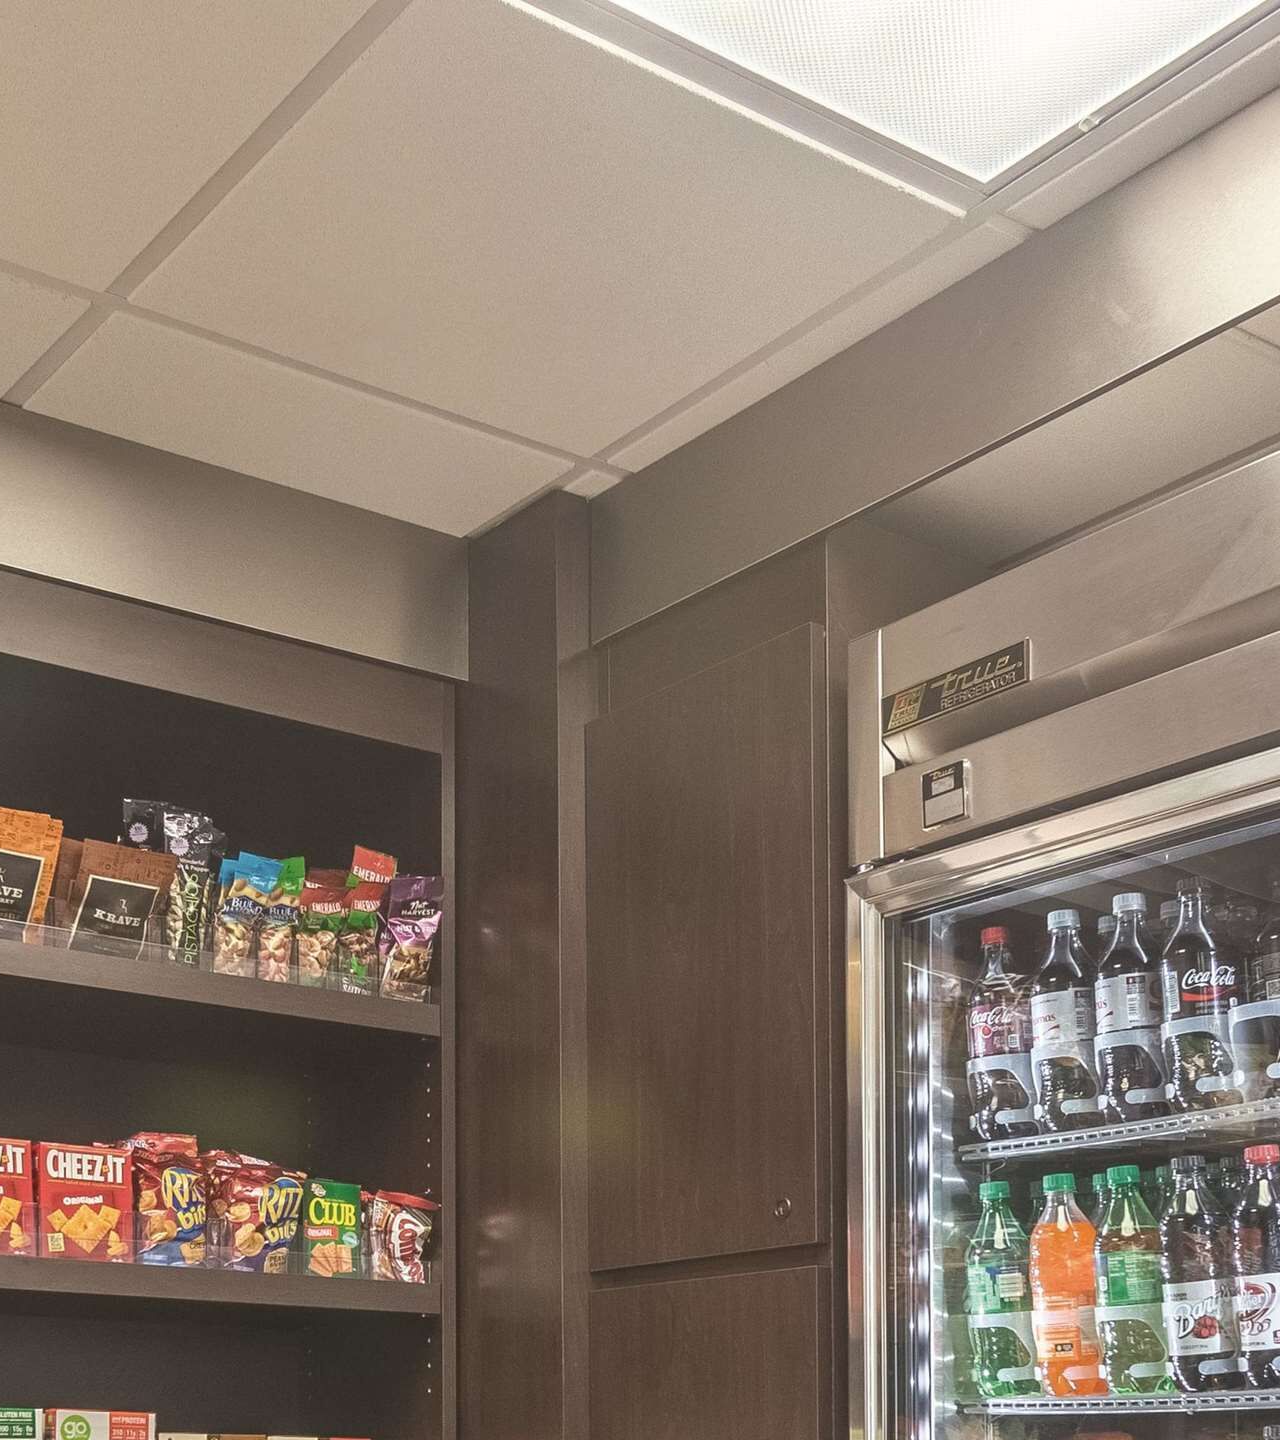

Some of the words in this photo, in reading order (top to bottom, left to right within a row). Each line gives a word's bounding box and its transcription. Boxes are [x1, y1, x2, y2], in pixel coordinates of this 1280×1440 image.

[940, 671, 1016, 709] REFRIGERATOR
[94, 909, 141, 927] KRAVE
[184, 874, 199, 964] PISTACHIOS
[309, 1198, 356, 1227] CLUB
[307, 1228, 334, 1237] ORIGINAL
[64, 1422, 87, 1439] go
